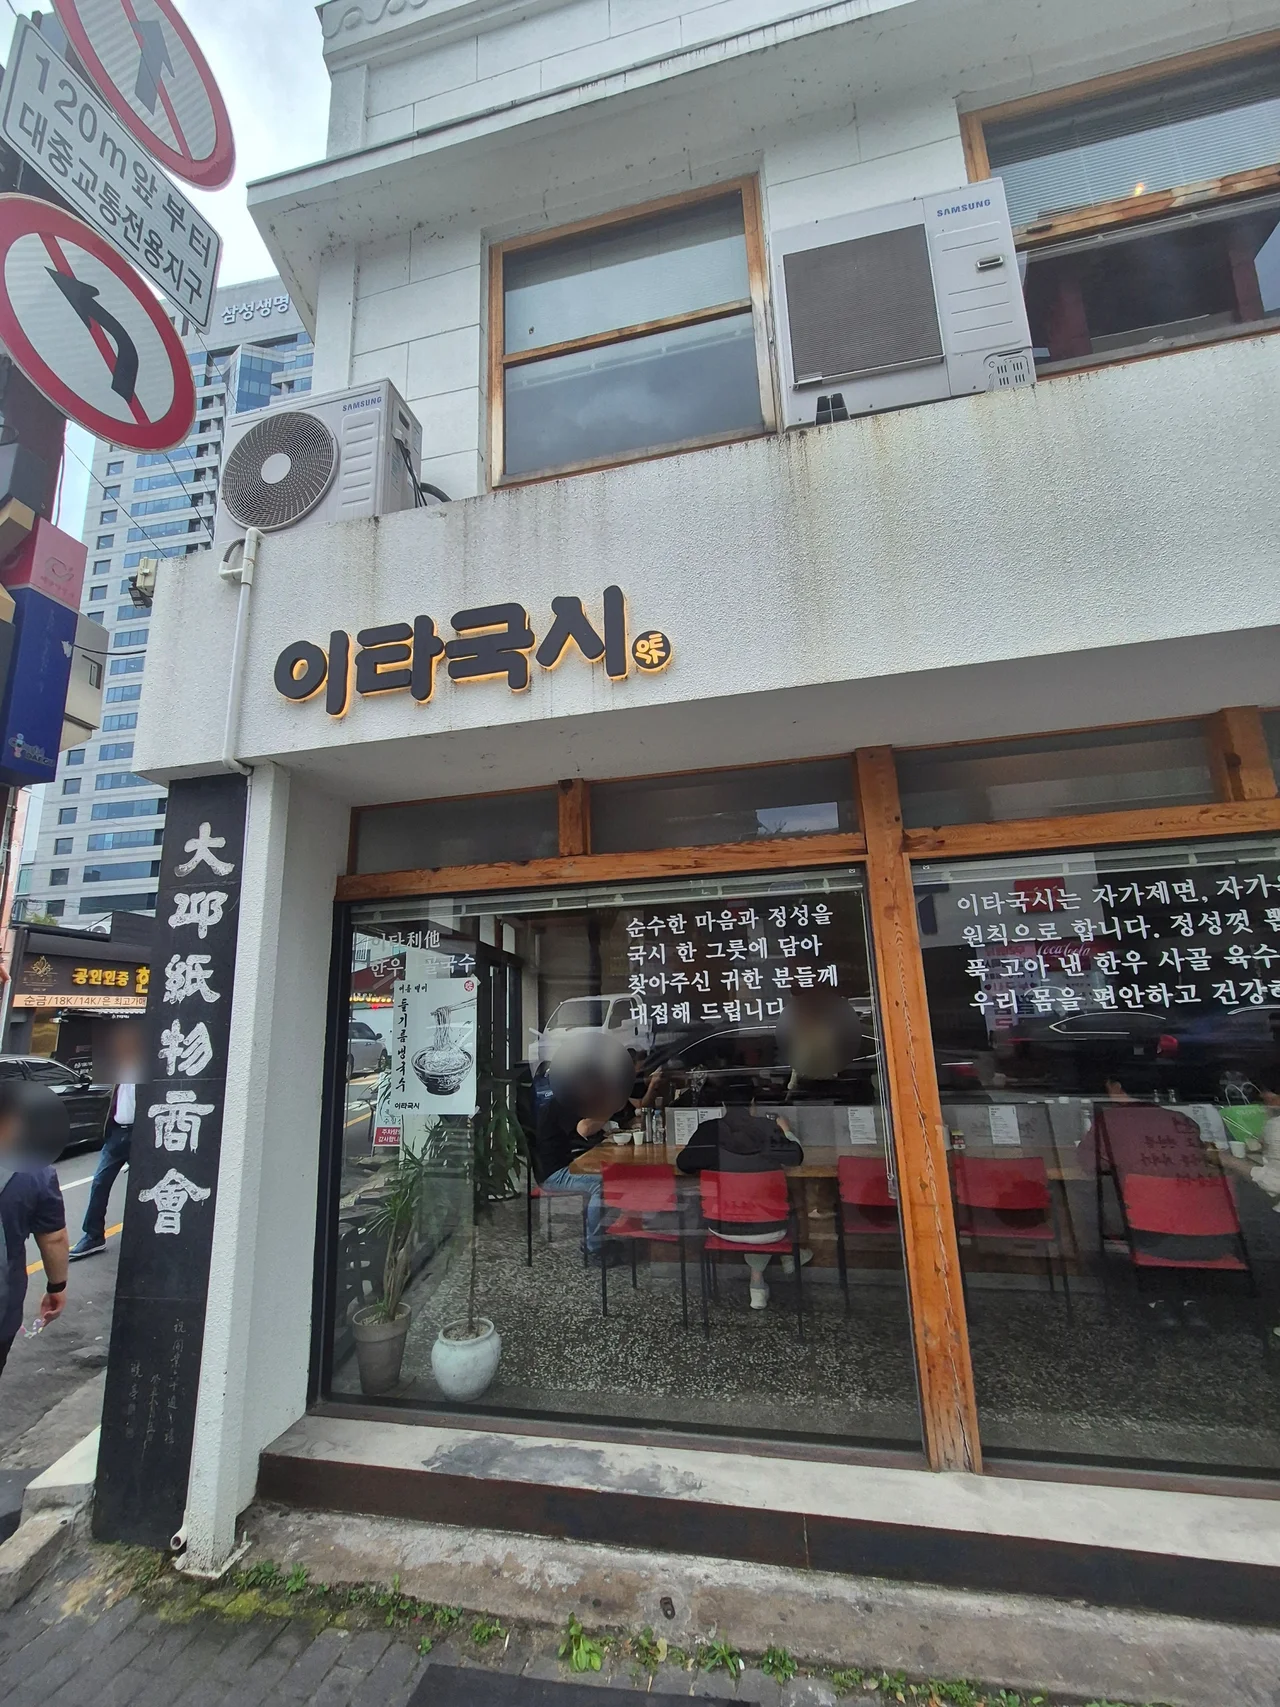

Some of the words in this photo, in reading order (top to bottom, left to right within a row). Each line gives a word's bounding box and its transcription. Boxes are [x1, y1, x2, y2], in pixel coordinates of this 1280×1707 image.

[18, 102, 203, 306] 대중교통전용지구
[937, 198, 991, 218] SAMSUNG
[221, 293, 290, 325] 삼성생명
[342, 396, 382, 412] SAMSUNG
[273, 584, 628, 717] 이타국시
[957, 889, 1082, 917] 이타국시는
[1091, 877, 1209, 908] 자가제면,
[1216, 873, 1280, 901] 자가
[625, 913, 686, 939] 순수한
[694, 907, 760, 933] 마음과
[767, 902, 834, 927] 정성을
[961, 922, 1063, 948] 원칙으로
[1070, 914, 1160, 943] 합니다.
[1170, 908, 1254, 937] 정성껏
[370, 958, 405, 978] 한우
[409, 953, 477, 975] 골국수
[626, 944, 666, 966] 국시
[676, 941, 698, 963] 한
[705, 937, 768, 962] 그릇에
[778, 934, 823, 958] 담아
[964, 958, 990, 982] 푹
[1000, 954, 1050, 980] 고아
[1058, 952, 1085, 978] 낸
[1092, 947, 1148, 976] 한우
[1158, 943, 1213, 972] 사골
[1223, 943, 1280, 970] 육수
[72, 967, 130, 987] 공인인증
[627, 971, 711, 996] 찾아주신
[720, 967, 764, 992] 귀한
[771, 964, 838, 989] 분들께
[23, 995, 111, 1006] 순금/18K/14K/은
[629, 1001, 691, 1025] 대접해
[699, 997, 786, 1022] 드립니다
[969, 989, 1019, 1016] 우리
[1030, 986, 1083, 1013] 몸을
[1092, 977, 1202, 1011] 편안하고
[395, 998, 409, 1092] 들기름냉국수
[394, 1102, 420, 1110] 이타국시
[381, 1128, 400, 1136] 주차장
